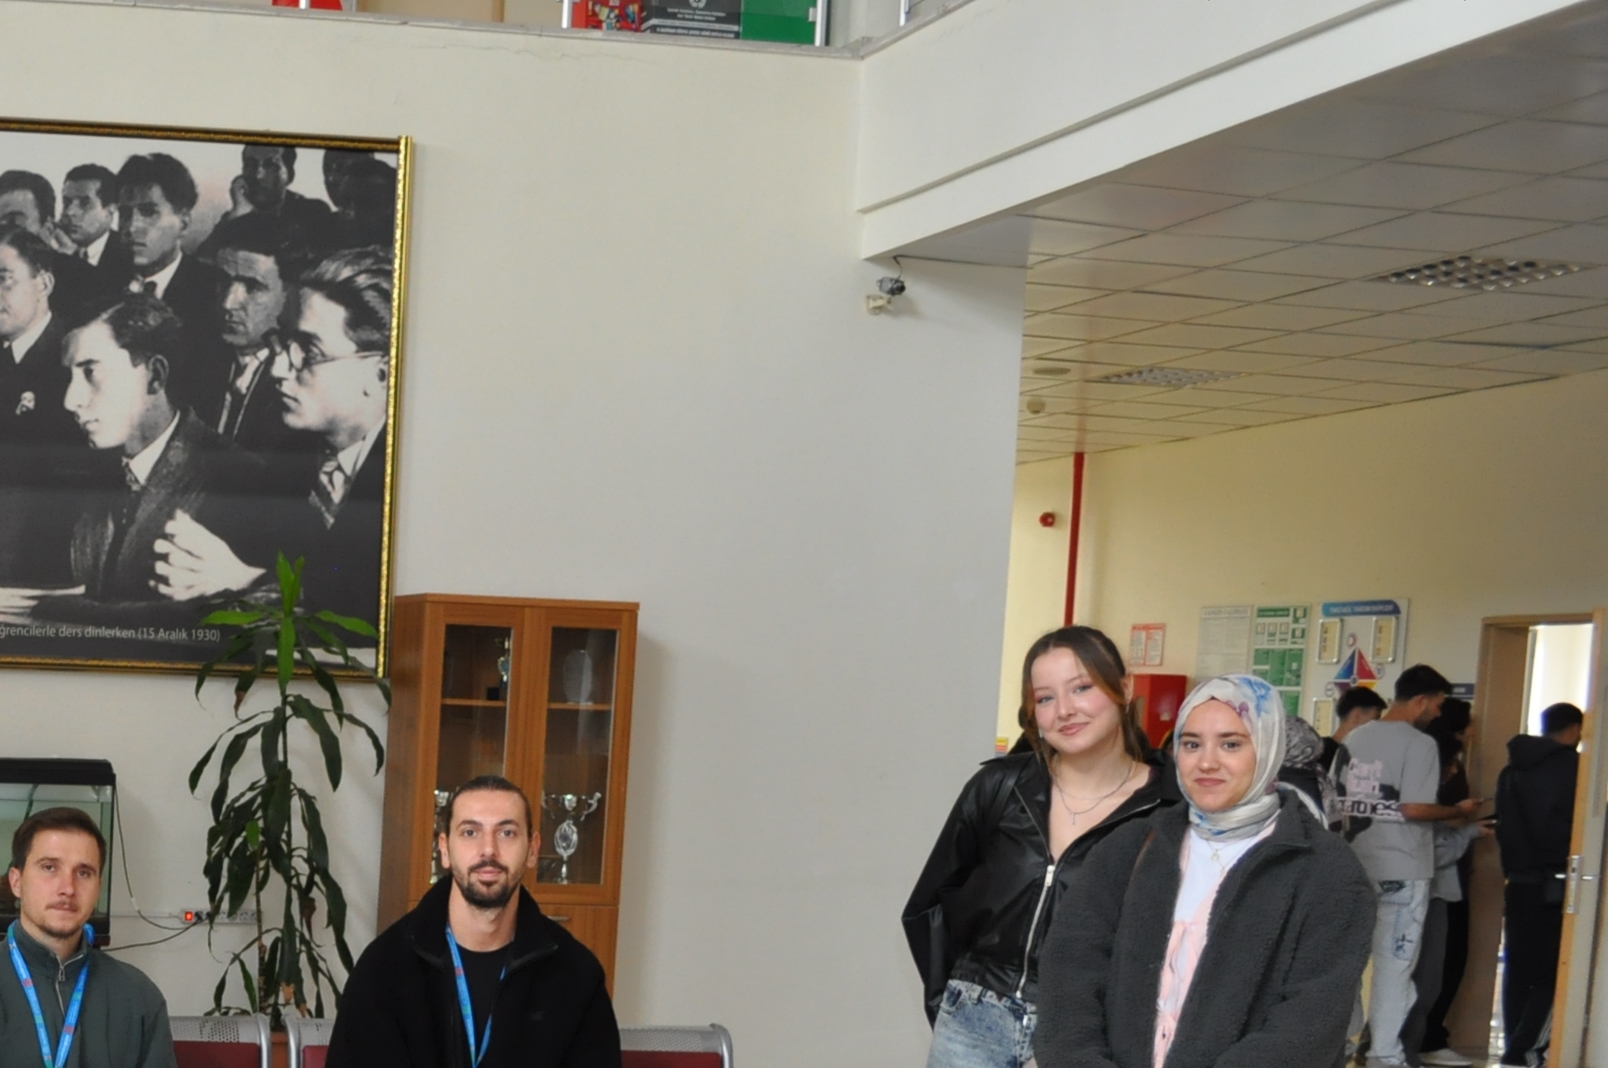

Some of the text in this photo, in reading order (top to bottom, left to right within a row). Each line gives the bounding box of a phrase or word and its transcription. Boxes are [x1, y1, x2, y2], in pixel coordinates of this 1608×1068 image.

[58, 625, 82, 638] ders
[84, 626, 136, 639] dinlerken
[137, 628, 155, 641] (15
[157, 628, 188, 641] Aralık
[191, 628, 221, 642] 1930)
